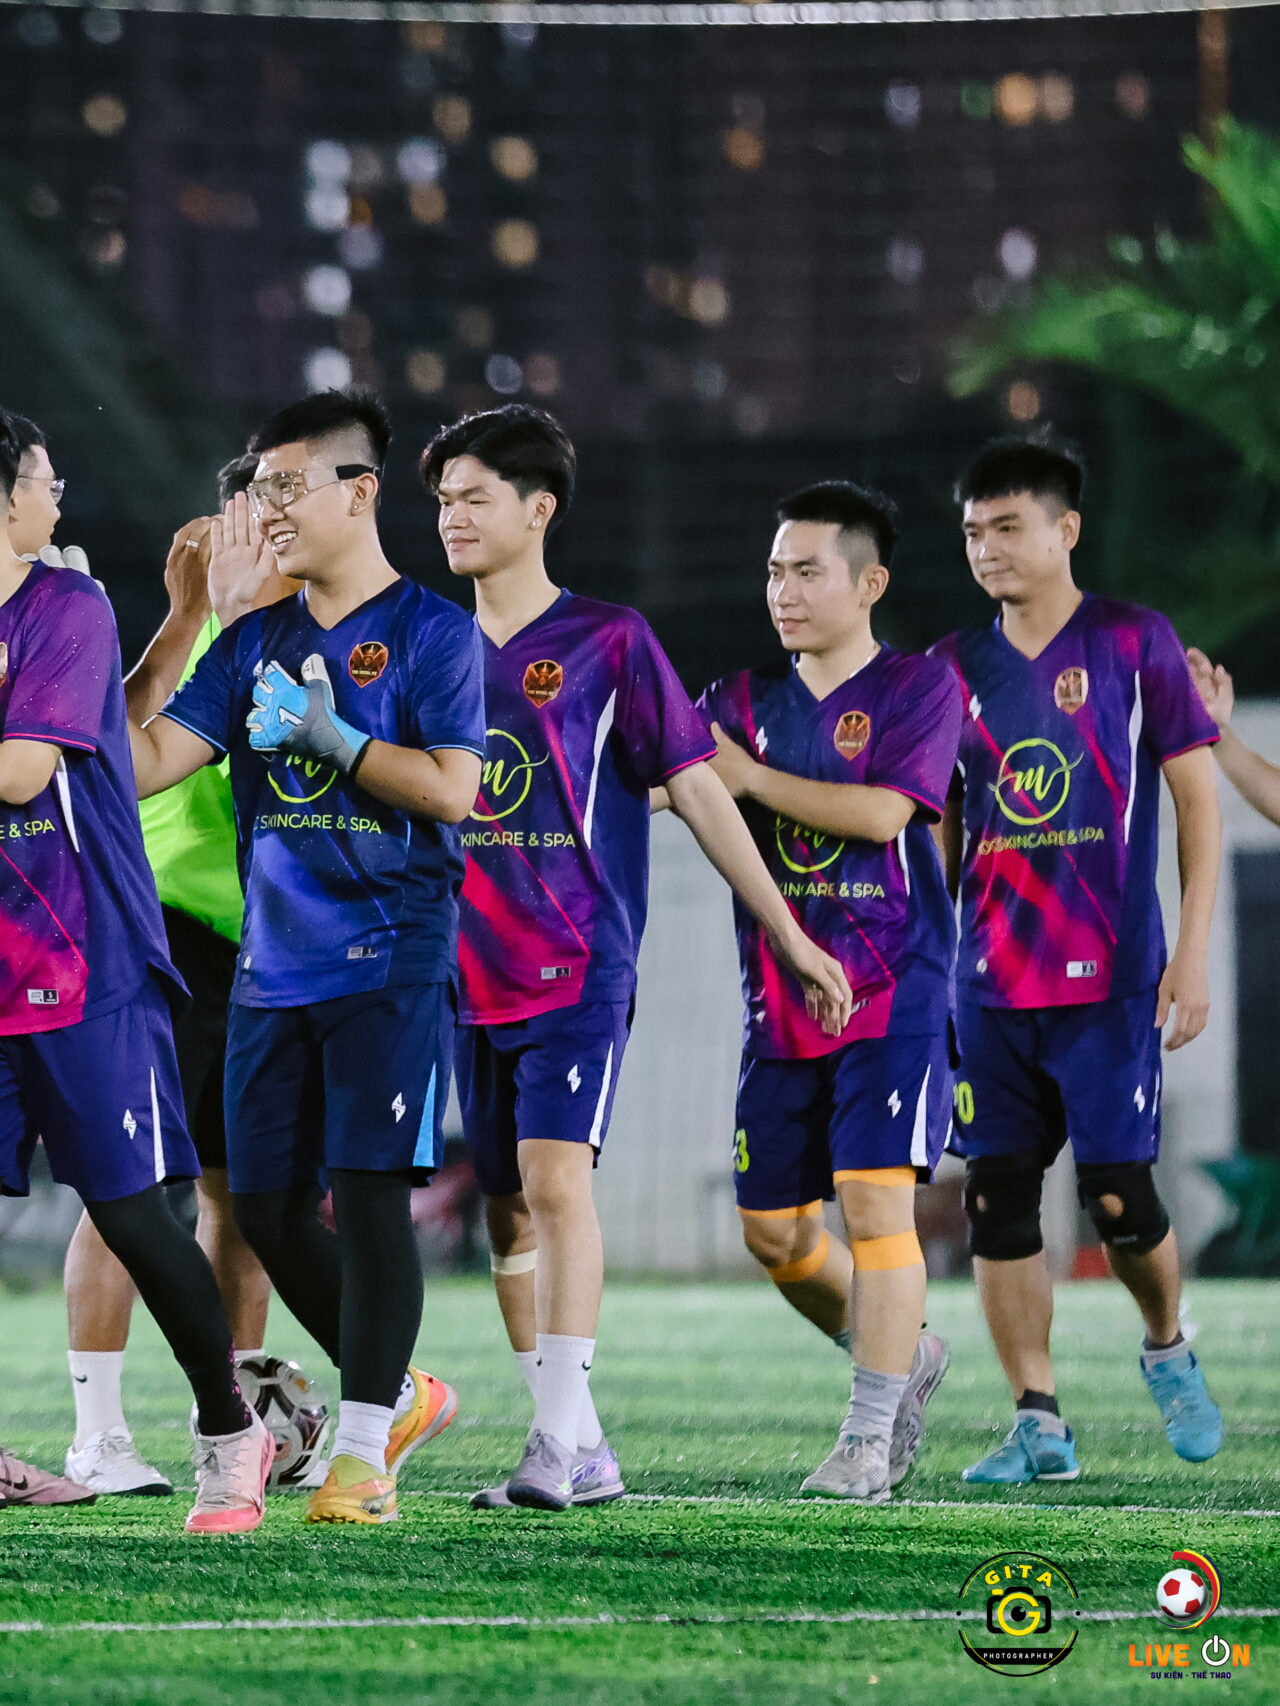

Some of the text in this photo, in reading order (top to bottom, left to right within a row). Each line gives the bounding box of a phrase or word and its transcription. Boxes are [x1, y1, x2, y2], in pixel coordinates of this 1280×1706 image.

[8, 823, 22, 838] &
[24, 819, 56, 837] SPA
[260, 813, 333, 830] SKINCARE
[336, 815, 347, 830] &
[350, 816, 382, 835] SPA
[528, 832, 539, 847] &
[543, 833, 576, 848] SPA
[838, 882, 850, 898] &
[852, 882, 886, 898] SPA
